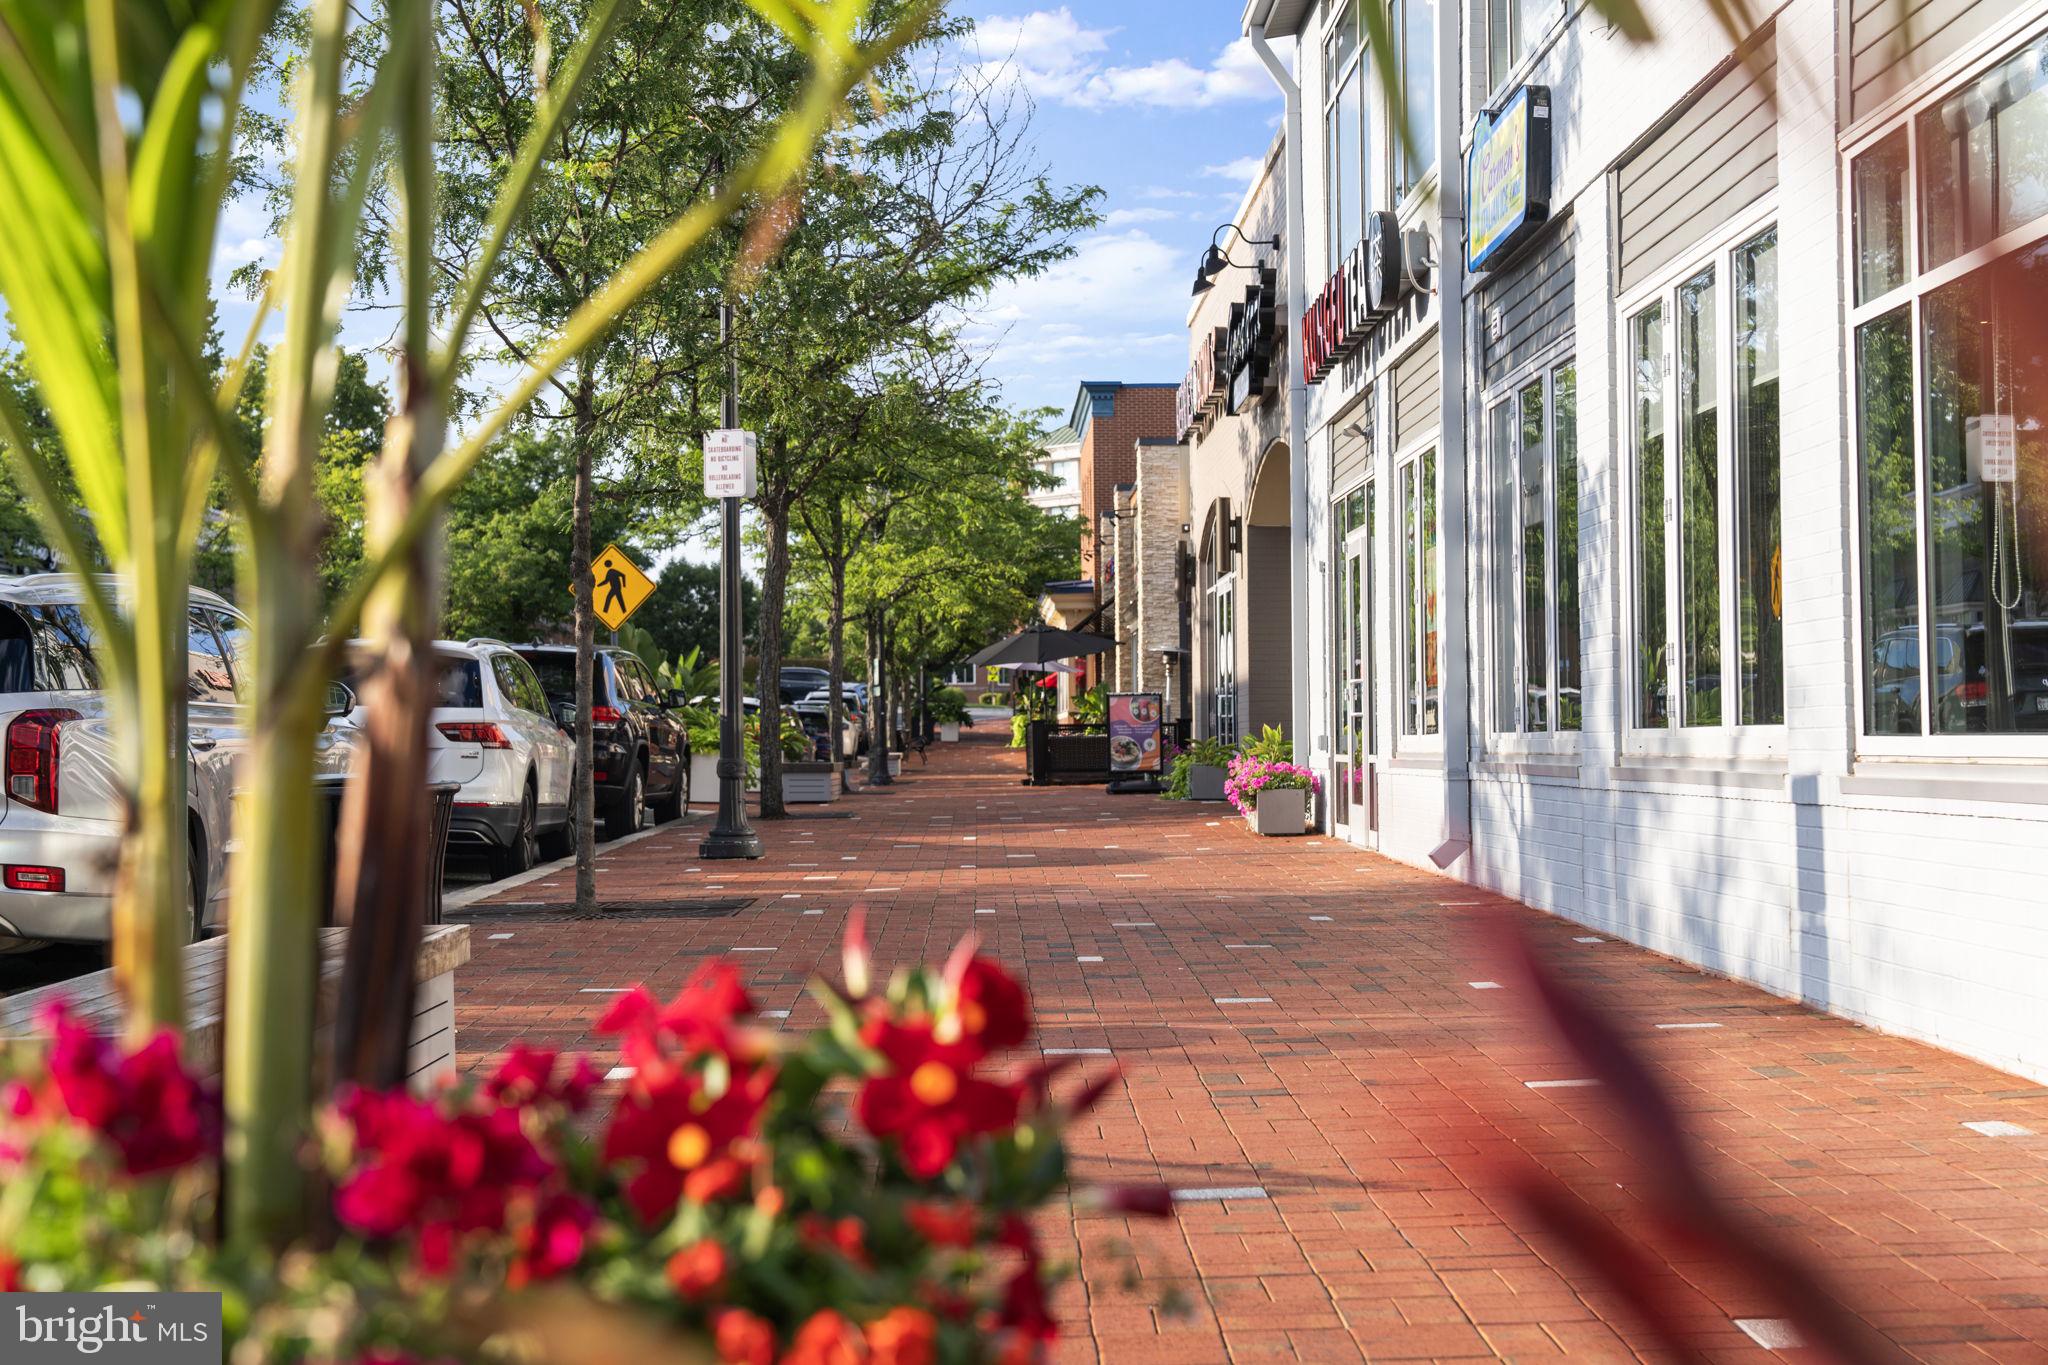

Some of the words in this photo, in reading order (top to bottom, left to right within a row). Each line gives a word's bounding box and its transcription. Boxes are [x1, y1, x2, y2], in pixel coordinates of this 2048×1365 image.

[1480, 124, 1521, 202] Carmen's
[1302, 283, 1330, 384] KUNG
[1330, 265, 1344, 353] FU
[1344, 240, 1367, 336] TEA
